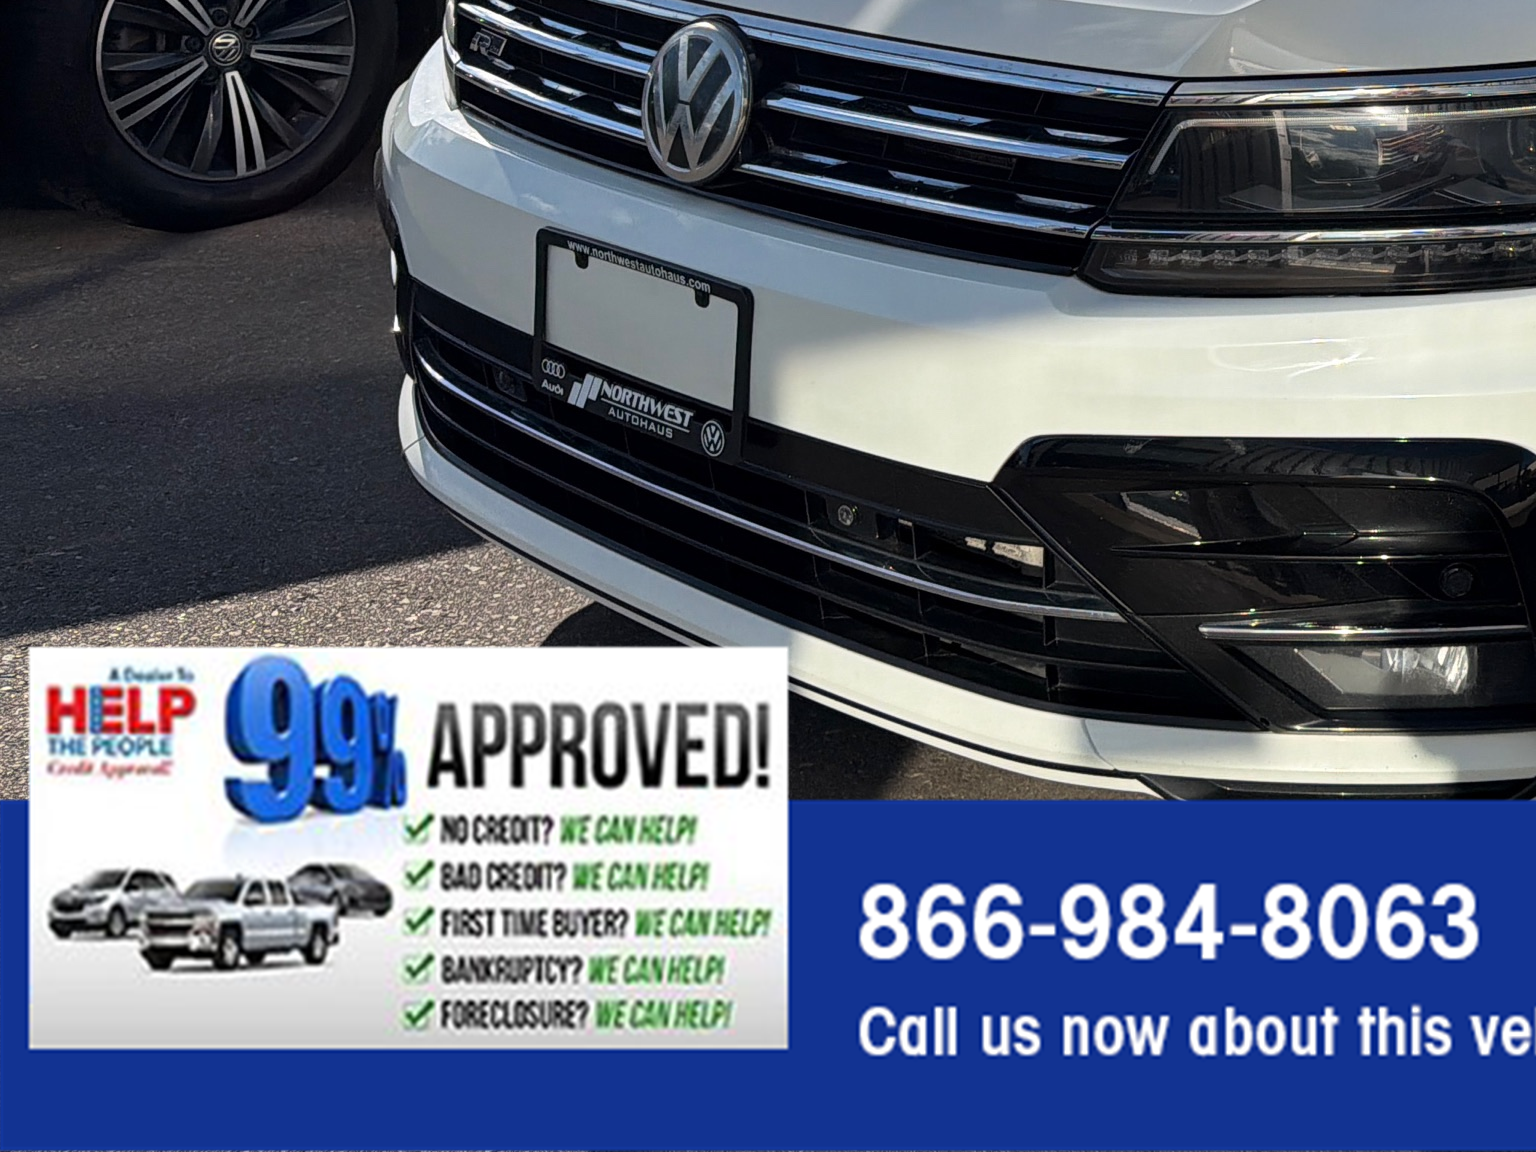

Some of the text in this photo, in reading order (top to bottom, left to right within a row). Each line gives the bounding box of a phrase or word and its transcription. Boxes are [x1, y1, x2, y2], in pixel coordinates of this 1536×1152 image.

[567, 240, 711, 294] www.northwestautohaus.com
[541, 379, 564, 395] Audi
[600, 380, 694, 428] NORTHWEST
[608, 406, 673, 439] AUTOHAUS
